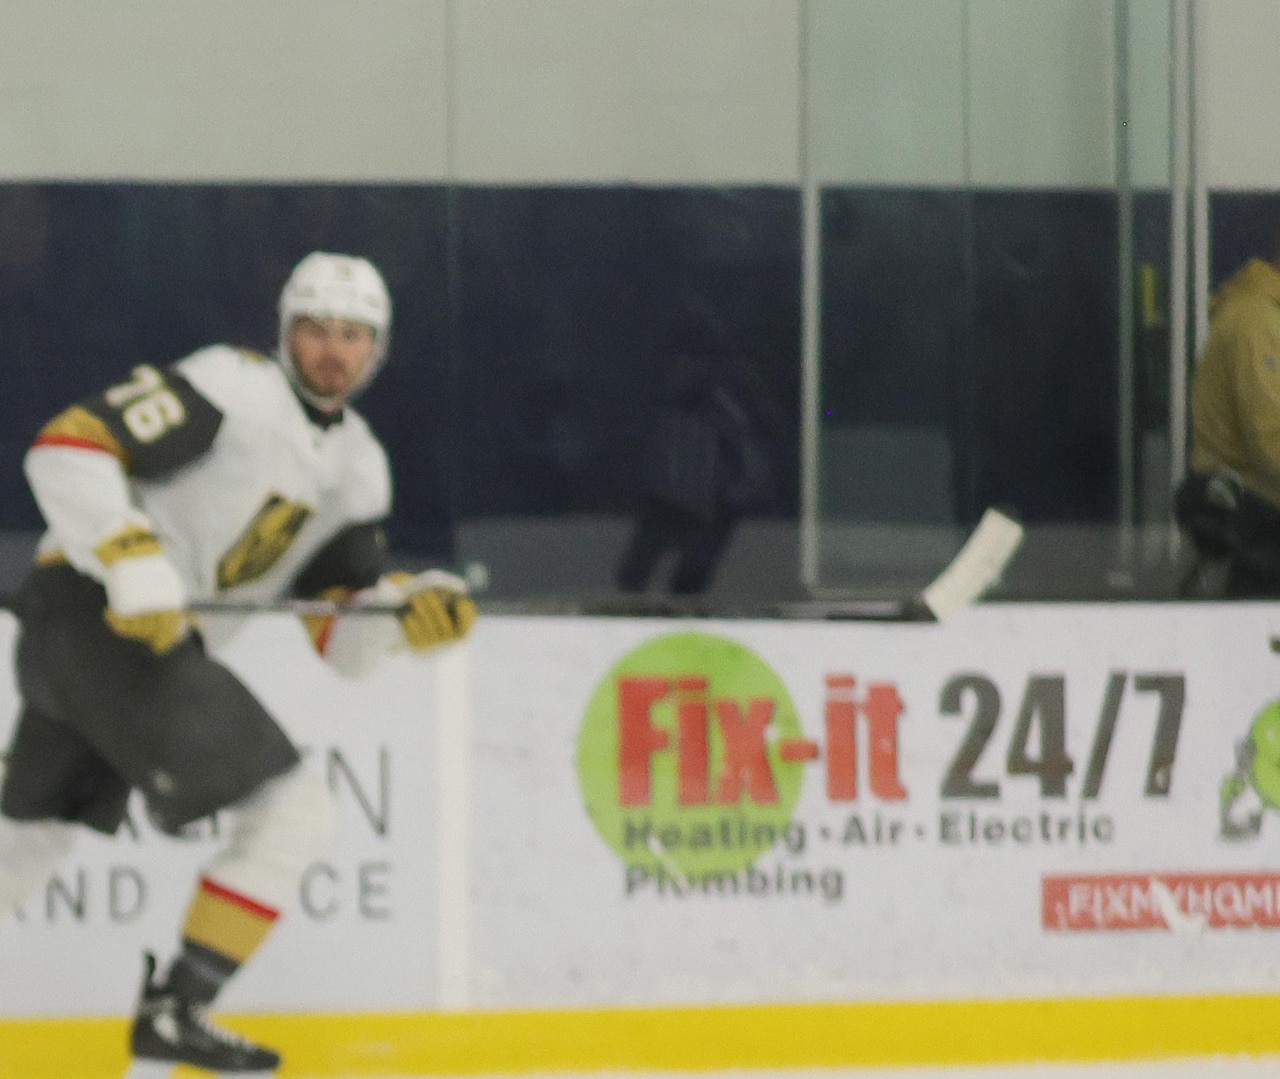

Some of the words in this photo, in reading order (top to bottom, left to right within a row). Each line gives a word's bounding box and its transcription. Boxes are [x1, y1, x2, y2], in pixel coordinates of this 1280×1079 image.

[105, 363, 186, 445] 76
[618, 674, 908, 806] Fix-it
[938, 672, 1185, 799] 24/7
[624, 811, 807, 854] Heating
[843, 812, 907, 845] Air
[939, 808, 1117, 846] Electric
